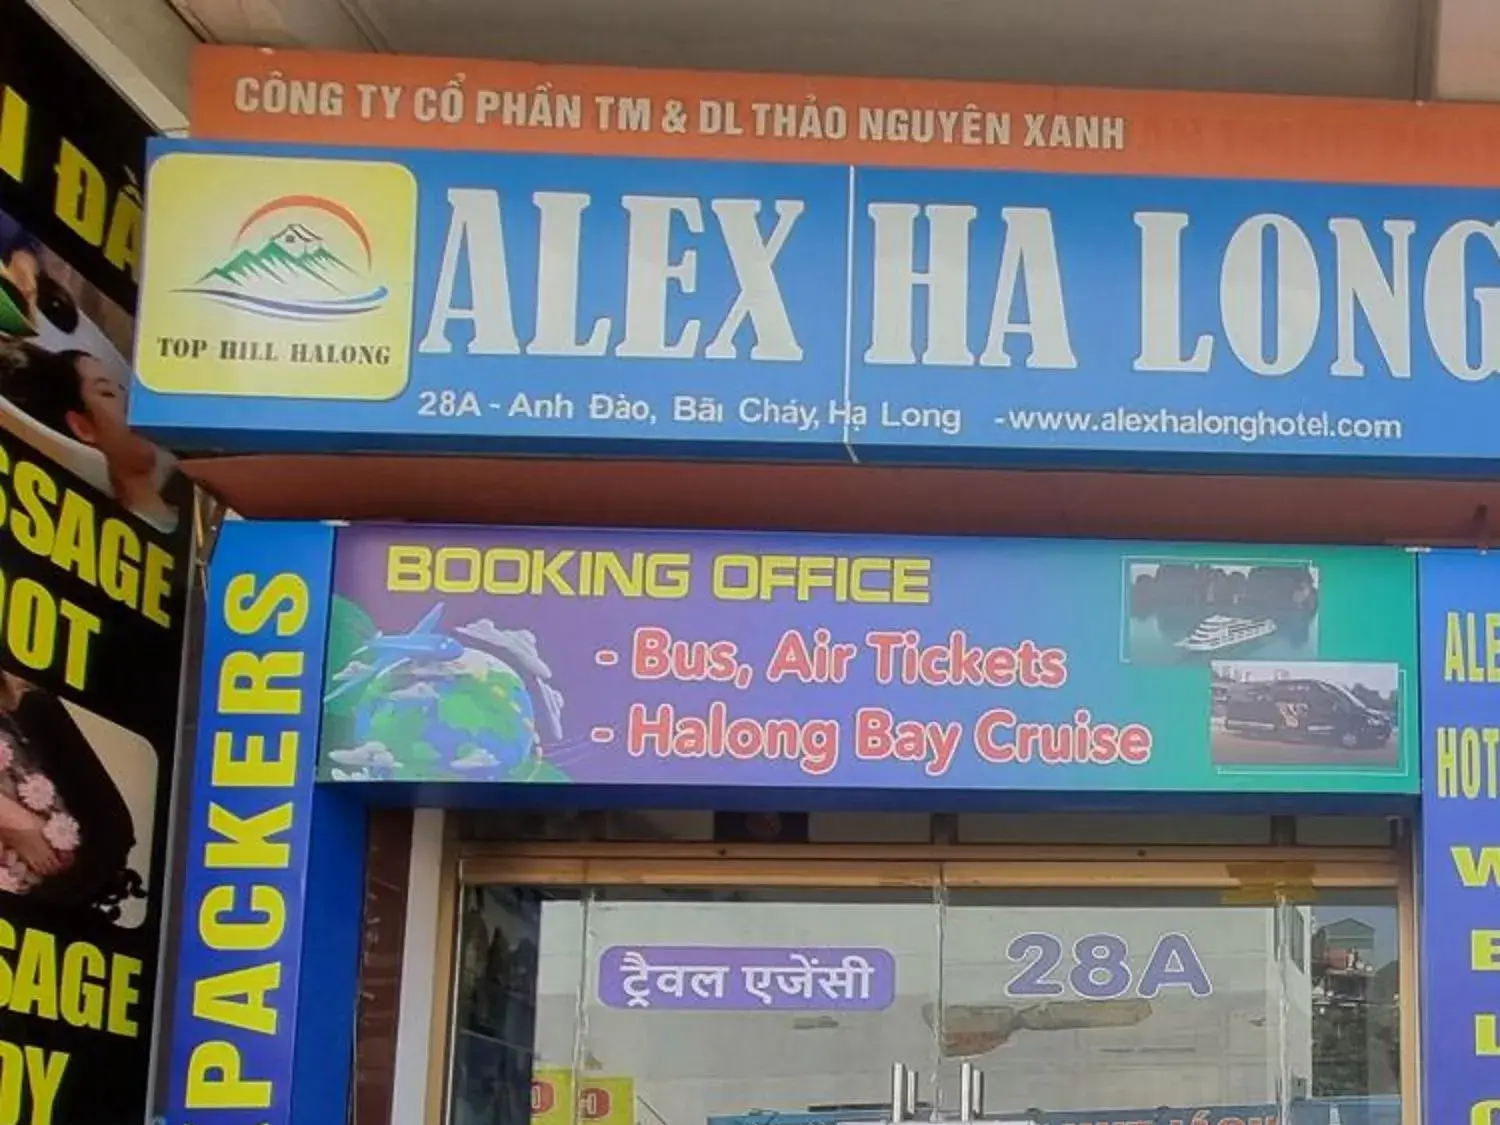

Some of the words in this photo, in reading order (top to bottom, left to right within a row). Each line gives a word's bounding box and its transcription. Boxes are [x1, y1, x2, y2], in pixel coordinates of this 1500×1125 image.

[235, 71, 344, 116] CÔNG
[356, 82, 402, 119] TY
[414, 72, 466, 123] CỔ
[476, 81, 581, 129] PHẦN
[594, 95, 650, 131] TM
[661, 101, 687, 135] &
[700, 100, 743, 135] DL
[752, 93, 847, 140] THẢO
[859, 103, 1010, 145] NGUYÊN
[1023, 112, 1124, 149] XANH
[54, 135, 146, 288] ĐẦ
[418, 188, 805, 361] ALEX
[863, 202, 1078, 369] HA
[157, 336, 208, 358] TOP
[219, 340, 279, 362] HILL
[290, 342, 391, 366] HALONG
[417, 391, 481, 418] 28A
[508, 391, 573, 420] Anh
[588, 393, 657, 424] Đào,
[739, 397, 818, 430] Cháy,
[828, 401, 867, 432] Hạ
[881, 402, 962, 434] Long
[386, 545, 691, 600] BOOKING
[712, 554, 932, 605] OFFICE
[631, 626, 753, 690] Bus,
[766, 628, 857, 685] Air
[866, 629, 1068, 689] Tickets
[627, 702, 840, 776] Halong
[855, 706, 962, 777] Bay
[973, 708, 1154, 765] Cruise
[620, 951, 730, 1007] ट्रैवल
[741, 953, 875, 1004] एजेंसी
[1003, 931, 1213, 999] 28A
